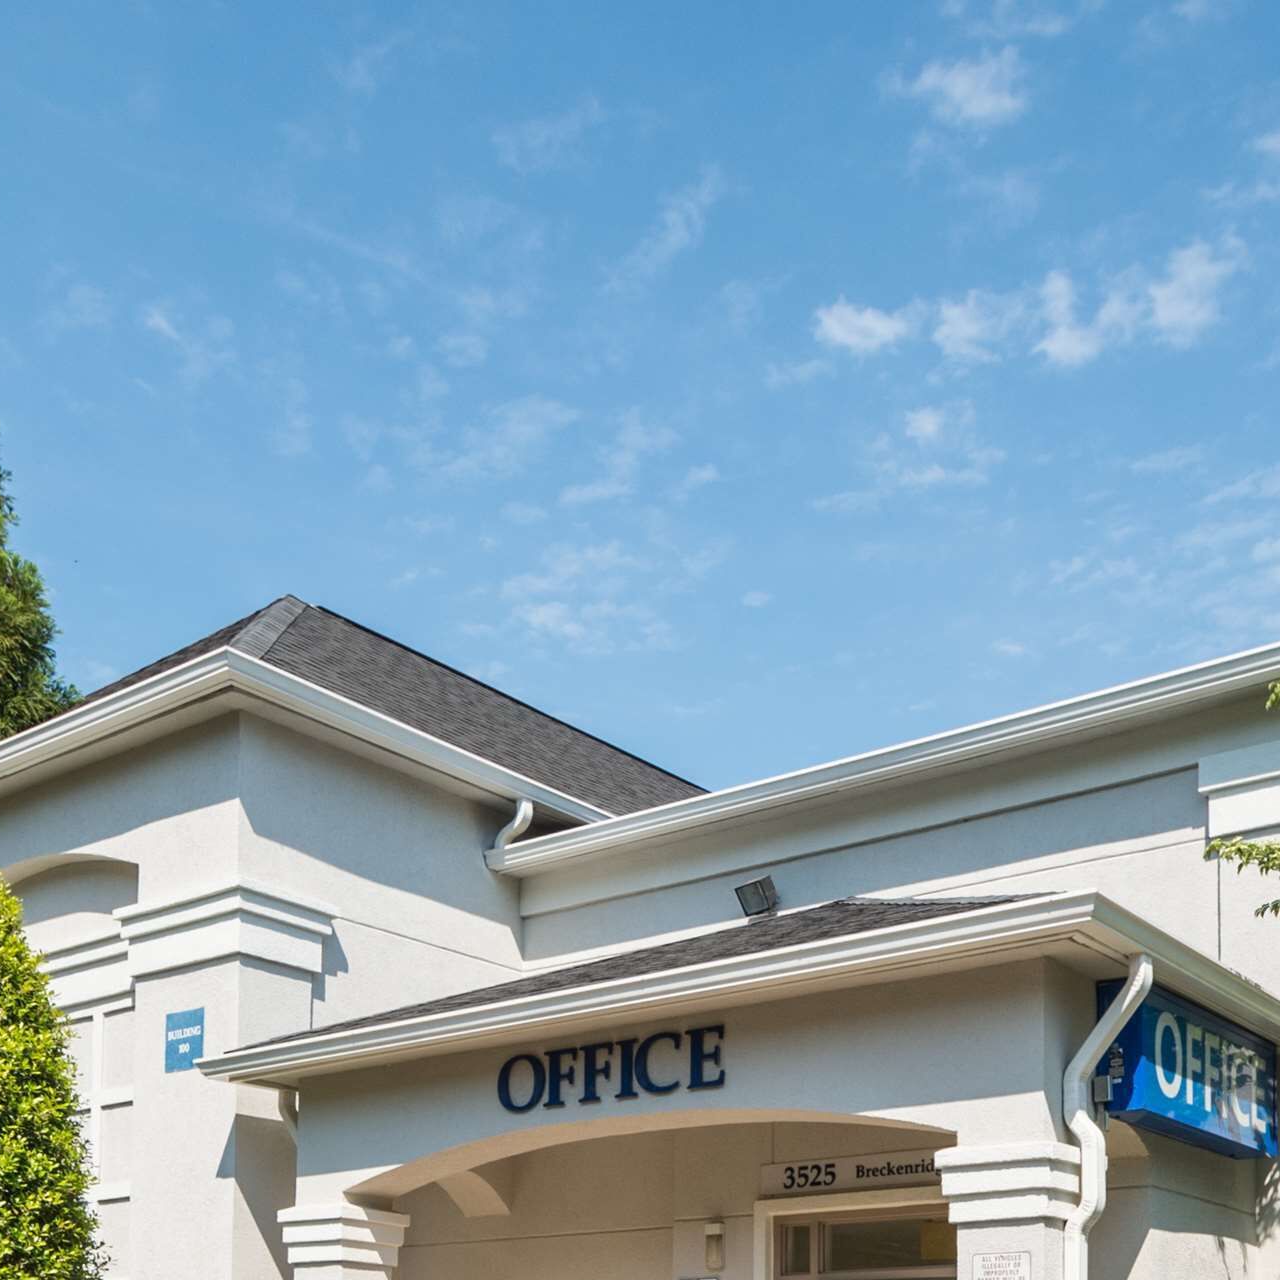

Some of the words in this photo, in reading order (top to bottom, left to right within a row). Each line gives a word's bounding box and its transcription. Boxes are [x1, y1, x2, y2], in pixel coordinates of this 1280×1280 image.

[497, 1024, 726, 1114] OFFICE
[1155, 1011, 1266, 1134] OFFICE
[783, 1163, 836, 1189] 3525
